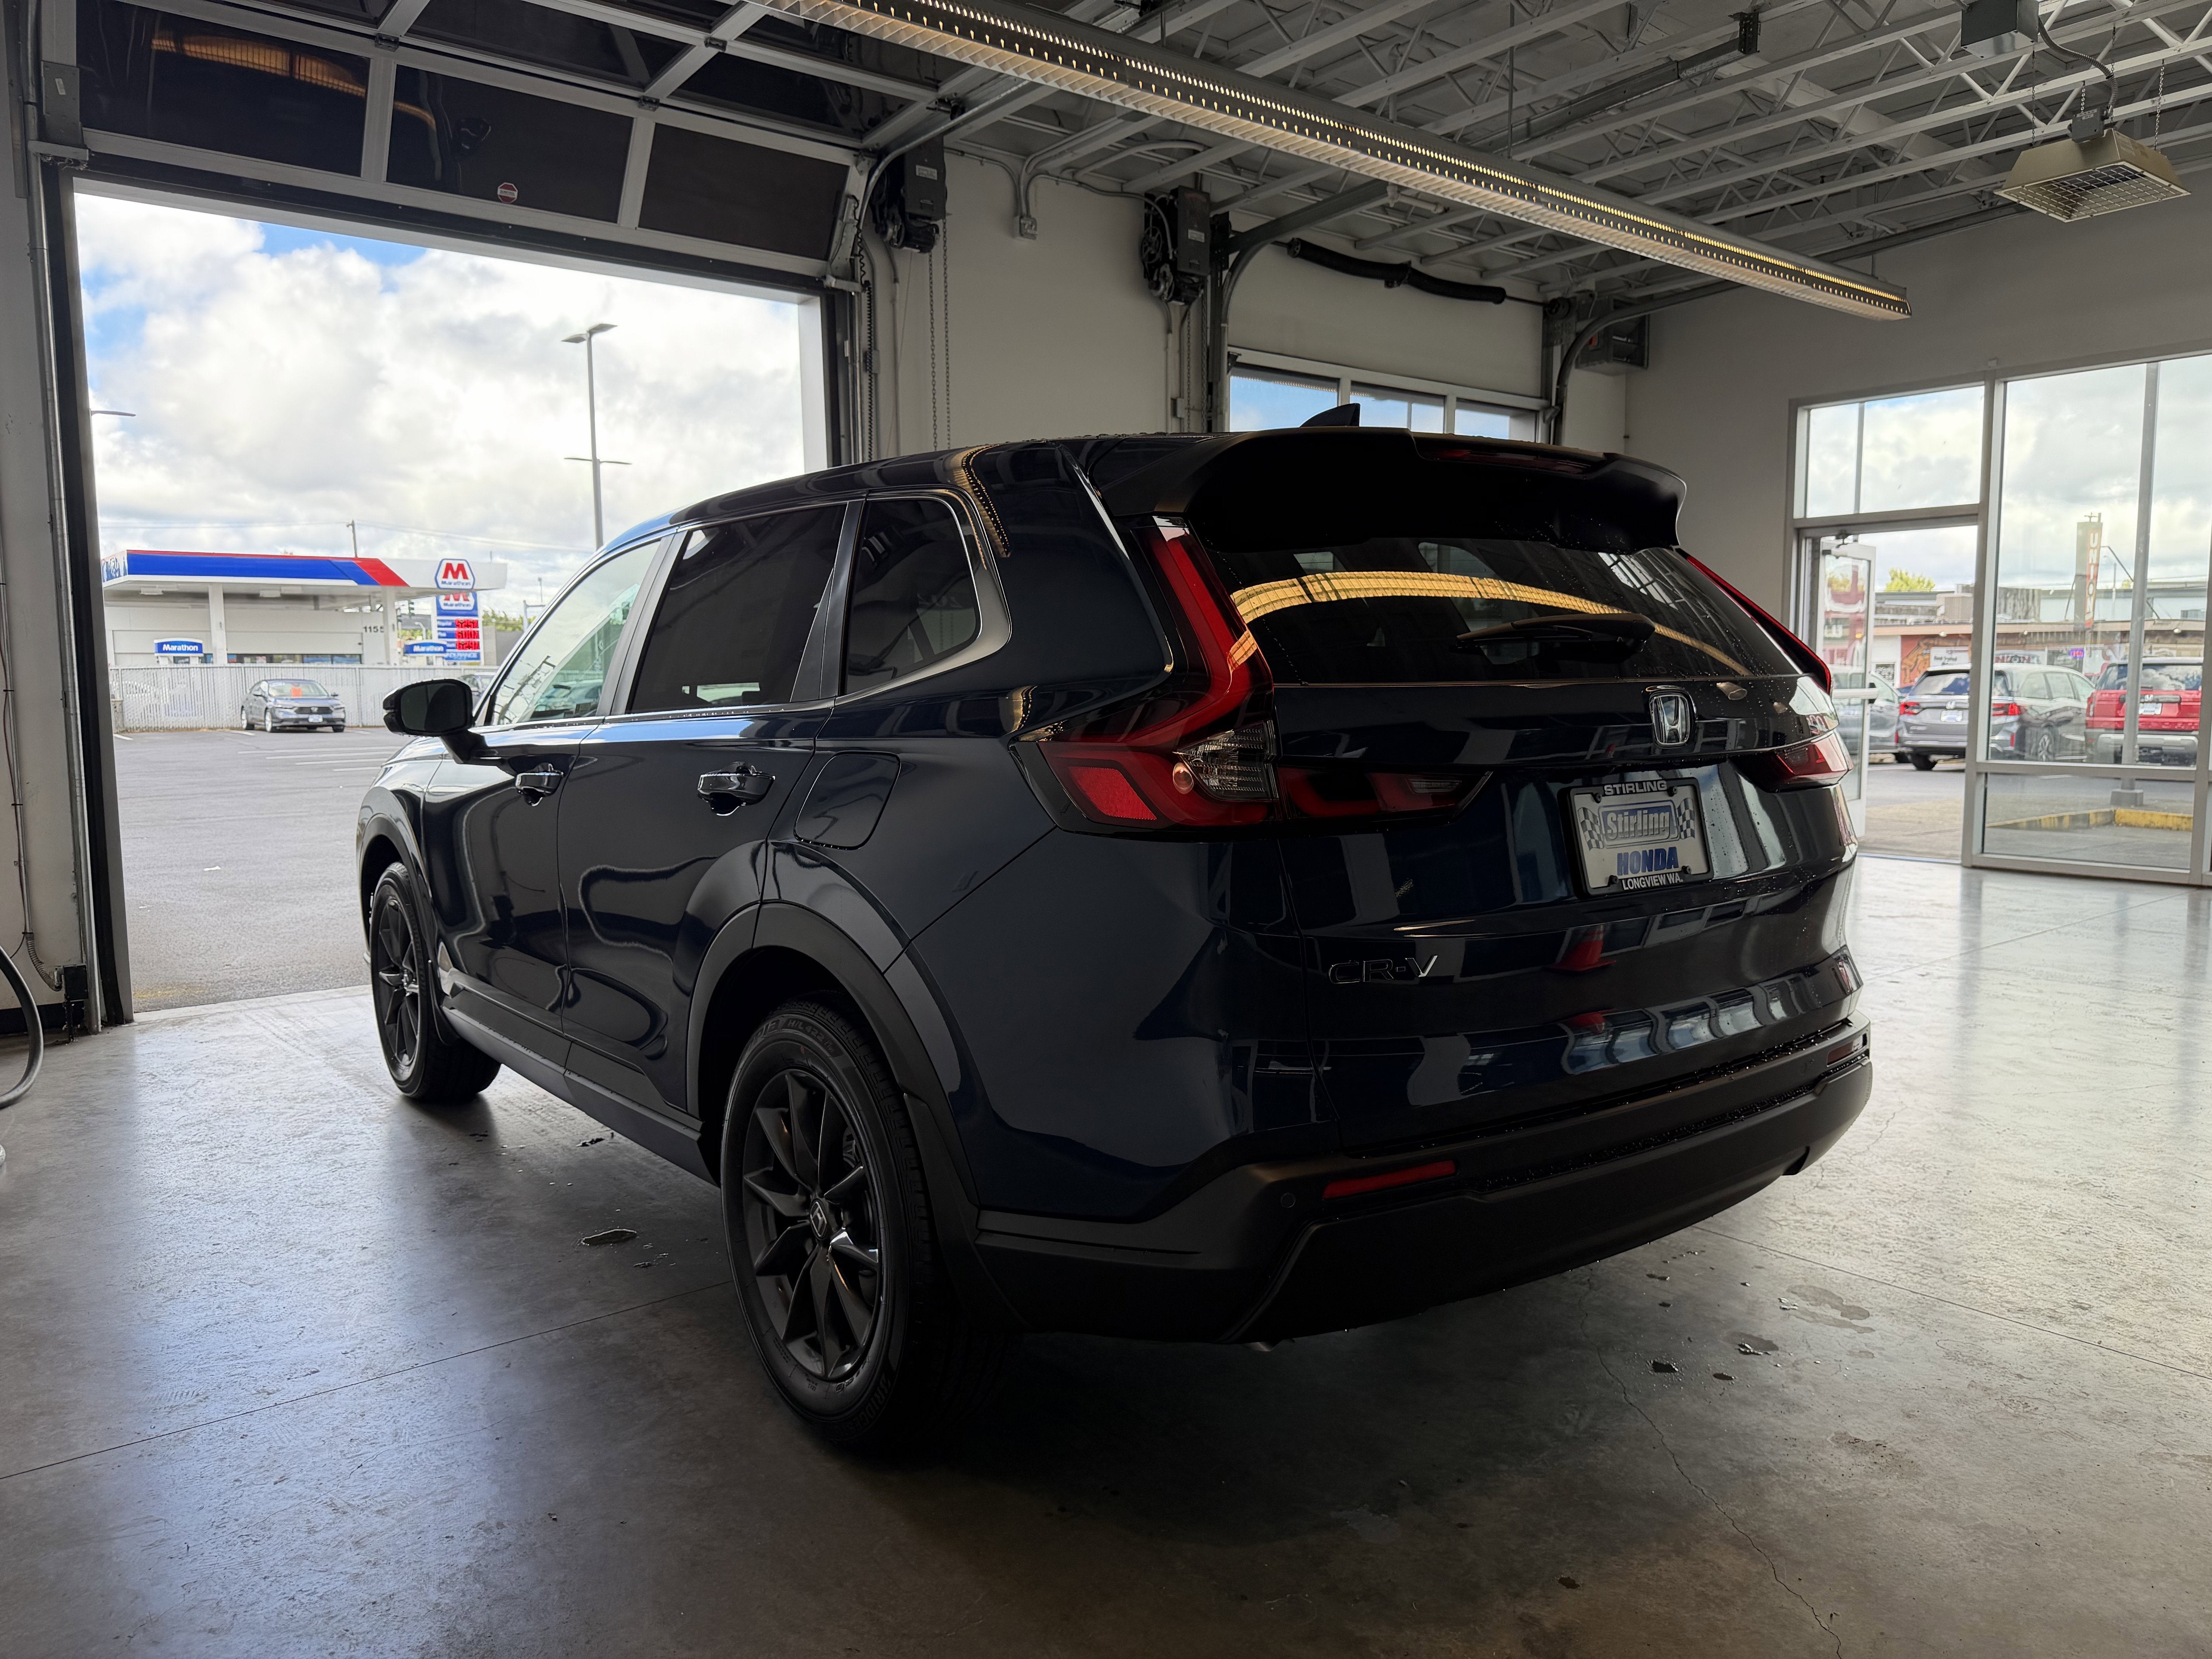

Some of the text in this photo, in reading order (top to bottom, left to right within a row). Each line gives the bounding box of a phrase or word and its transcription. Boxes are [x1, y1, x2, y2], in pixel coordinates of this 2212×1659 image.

[442, 563, 469, 580] M
[2085, 532, 2099, 617] UNION
[1604, 781, 1667, 795] STIRLING
[1607, 810, 1669, 840] Stirling
[1617, 847, 1679, 876] HONDA
[1622, 872, 1683, 890] LONGVIEW WA.
[1328, 954, 1437, 984] CR-V
[805, 1024, 825, 1042] 422
